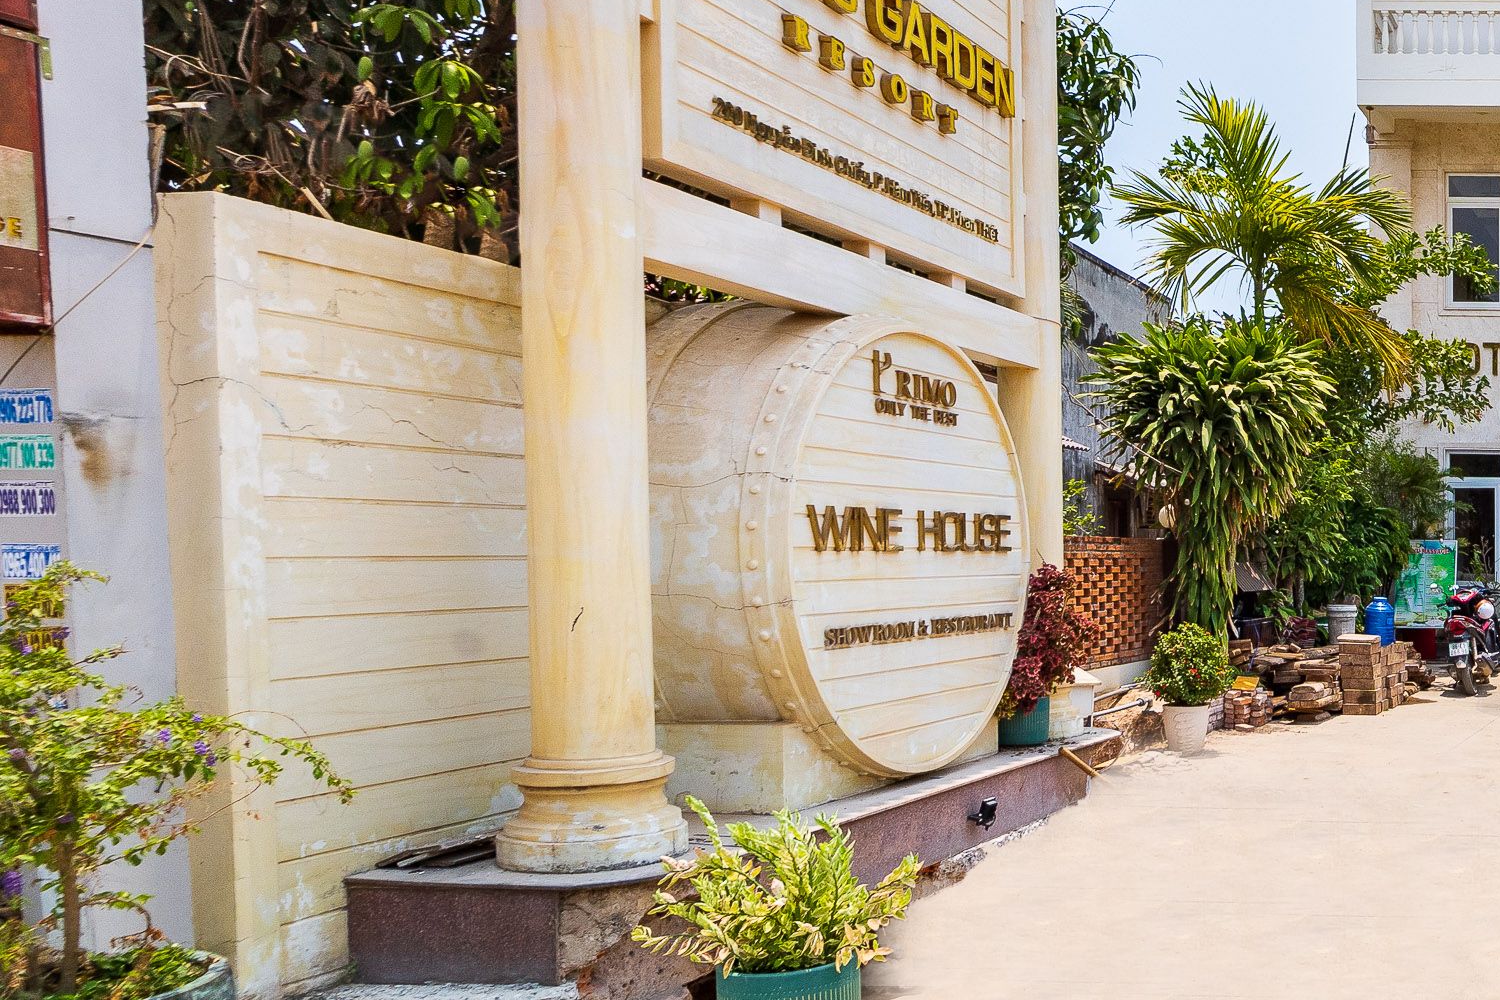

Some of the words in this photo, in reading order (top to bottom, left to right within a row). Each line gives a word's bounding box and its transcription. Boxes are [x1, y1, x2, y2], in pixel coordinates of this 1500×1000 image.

[782, 13, 959, 134] RESORT
[875, 398, 907, 417] ONLY
[910, 405, 931, 422] THE
[933, 409, 959, 427] BEST
[806, 504, 904, 552] WINE
[917, 510, 1012, 552] HOUSE
[823, 621, 915, 649] SHOWROOM
[917, 619, 929, 636] &
[931, 612, 1014, 635] RESTAURANT
